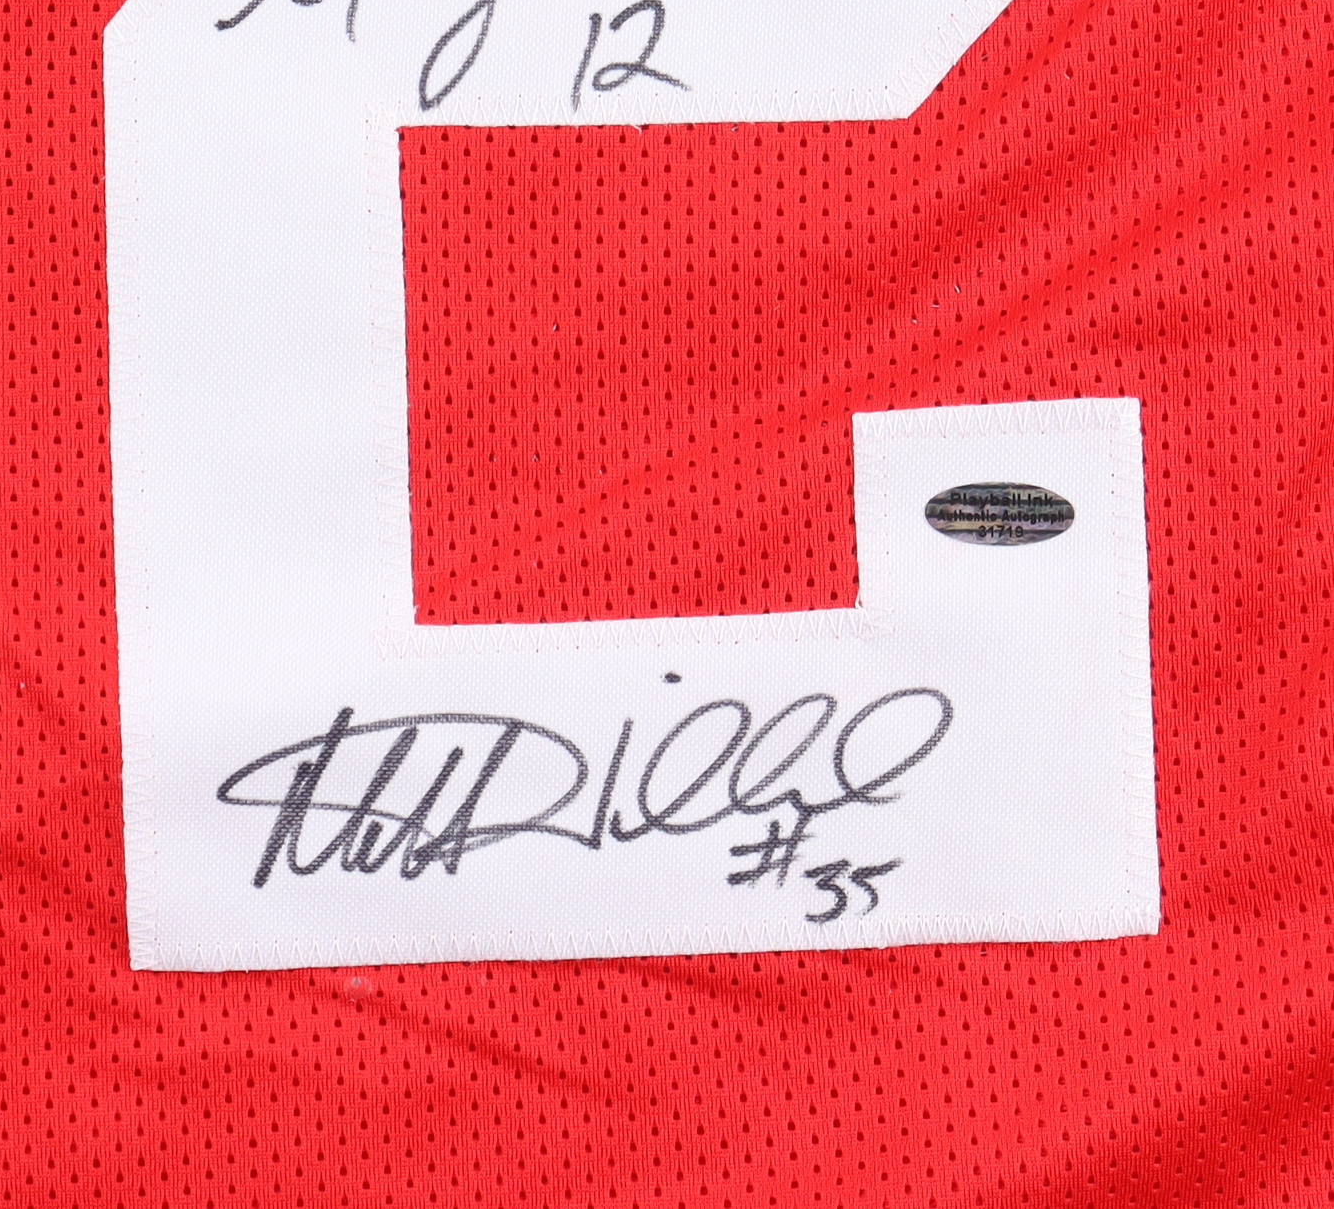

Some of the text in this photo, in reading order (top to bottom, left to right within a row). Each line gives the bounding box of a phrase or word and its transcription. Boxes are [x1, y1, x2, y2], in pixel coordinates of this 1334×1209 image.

[950, 492, 1054, 510] Playball Ink
[937, 509, 1065, 524] Authentic Autograph
[978, 524, 1024, 538] 31719
